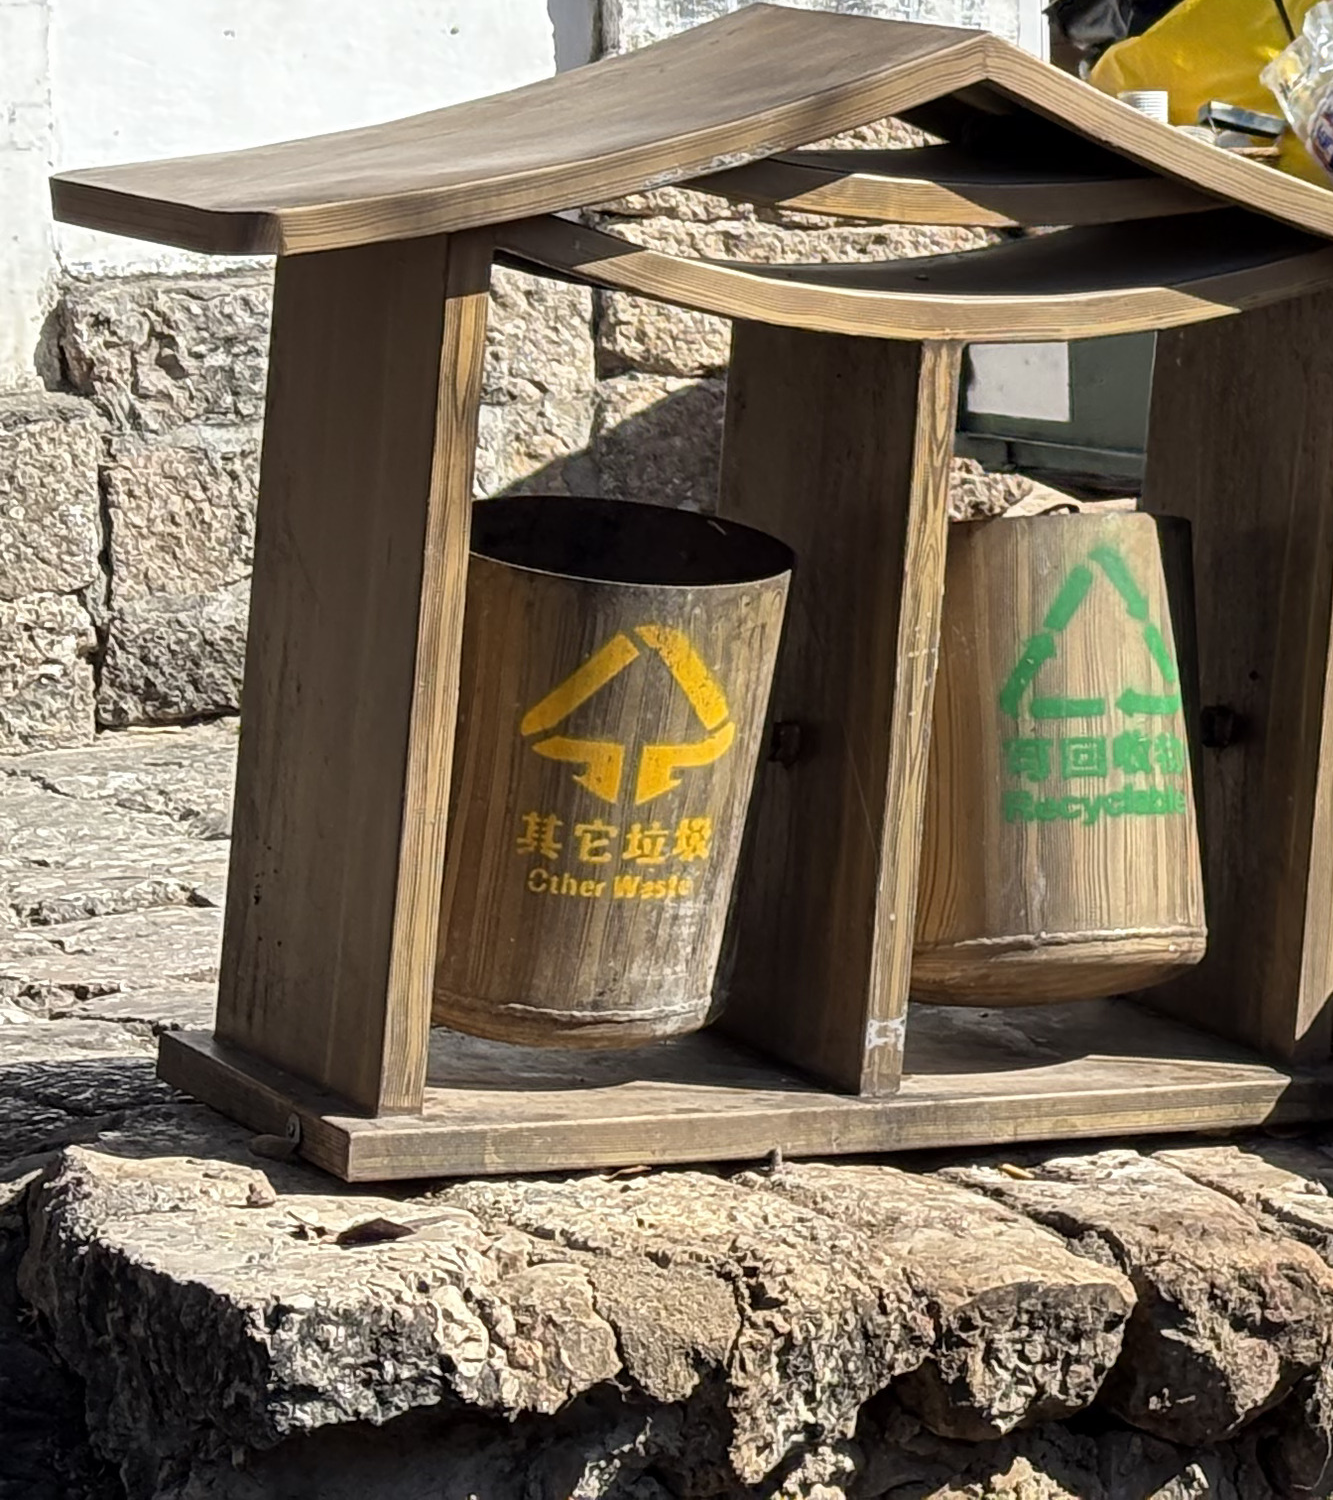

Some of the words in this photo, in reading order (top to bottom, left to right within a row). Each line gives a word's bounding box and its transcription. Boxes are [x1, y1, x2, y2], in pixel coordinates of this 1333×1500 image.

[1002, 730, 1185, 783] 可回收物
[516, 811, 713, 865] 其它垃圾
